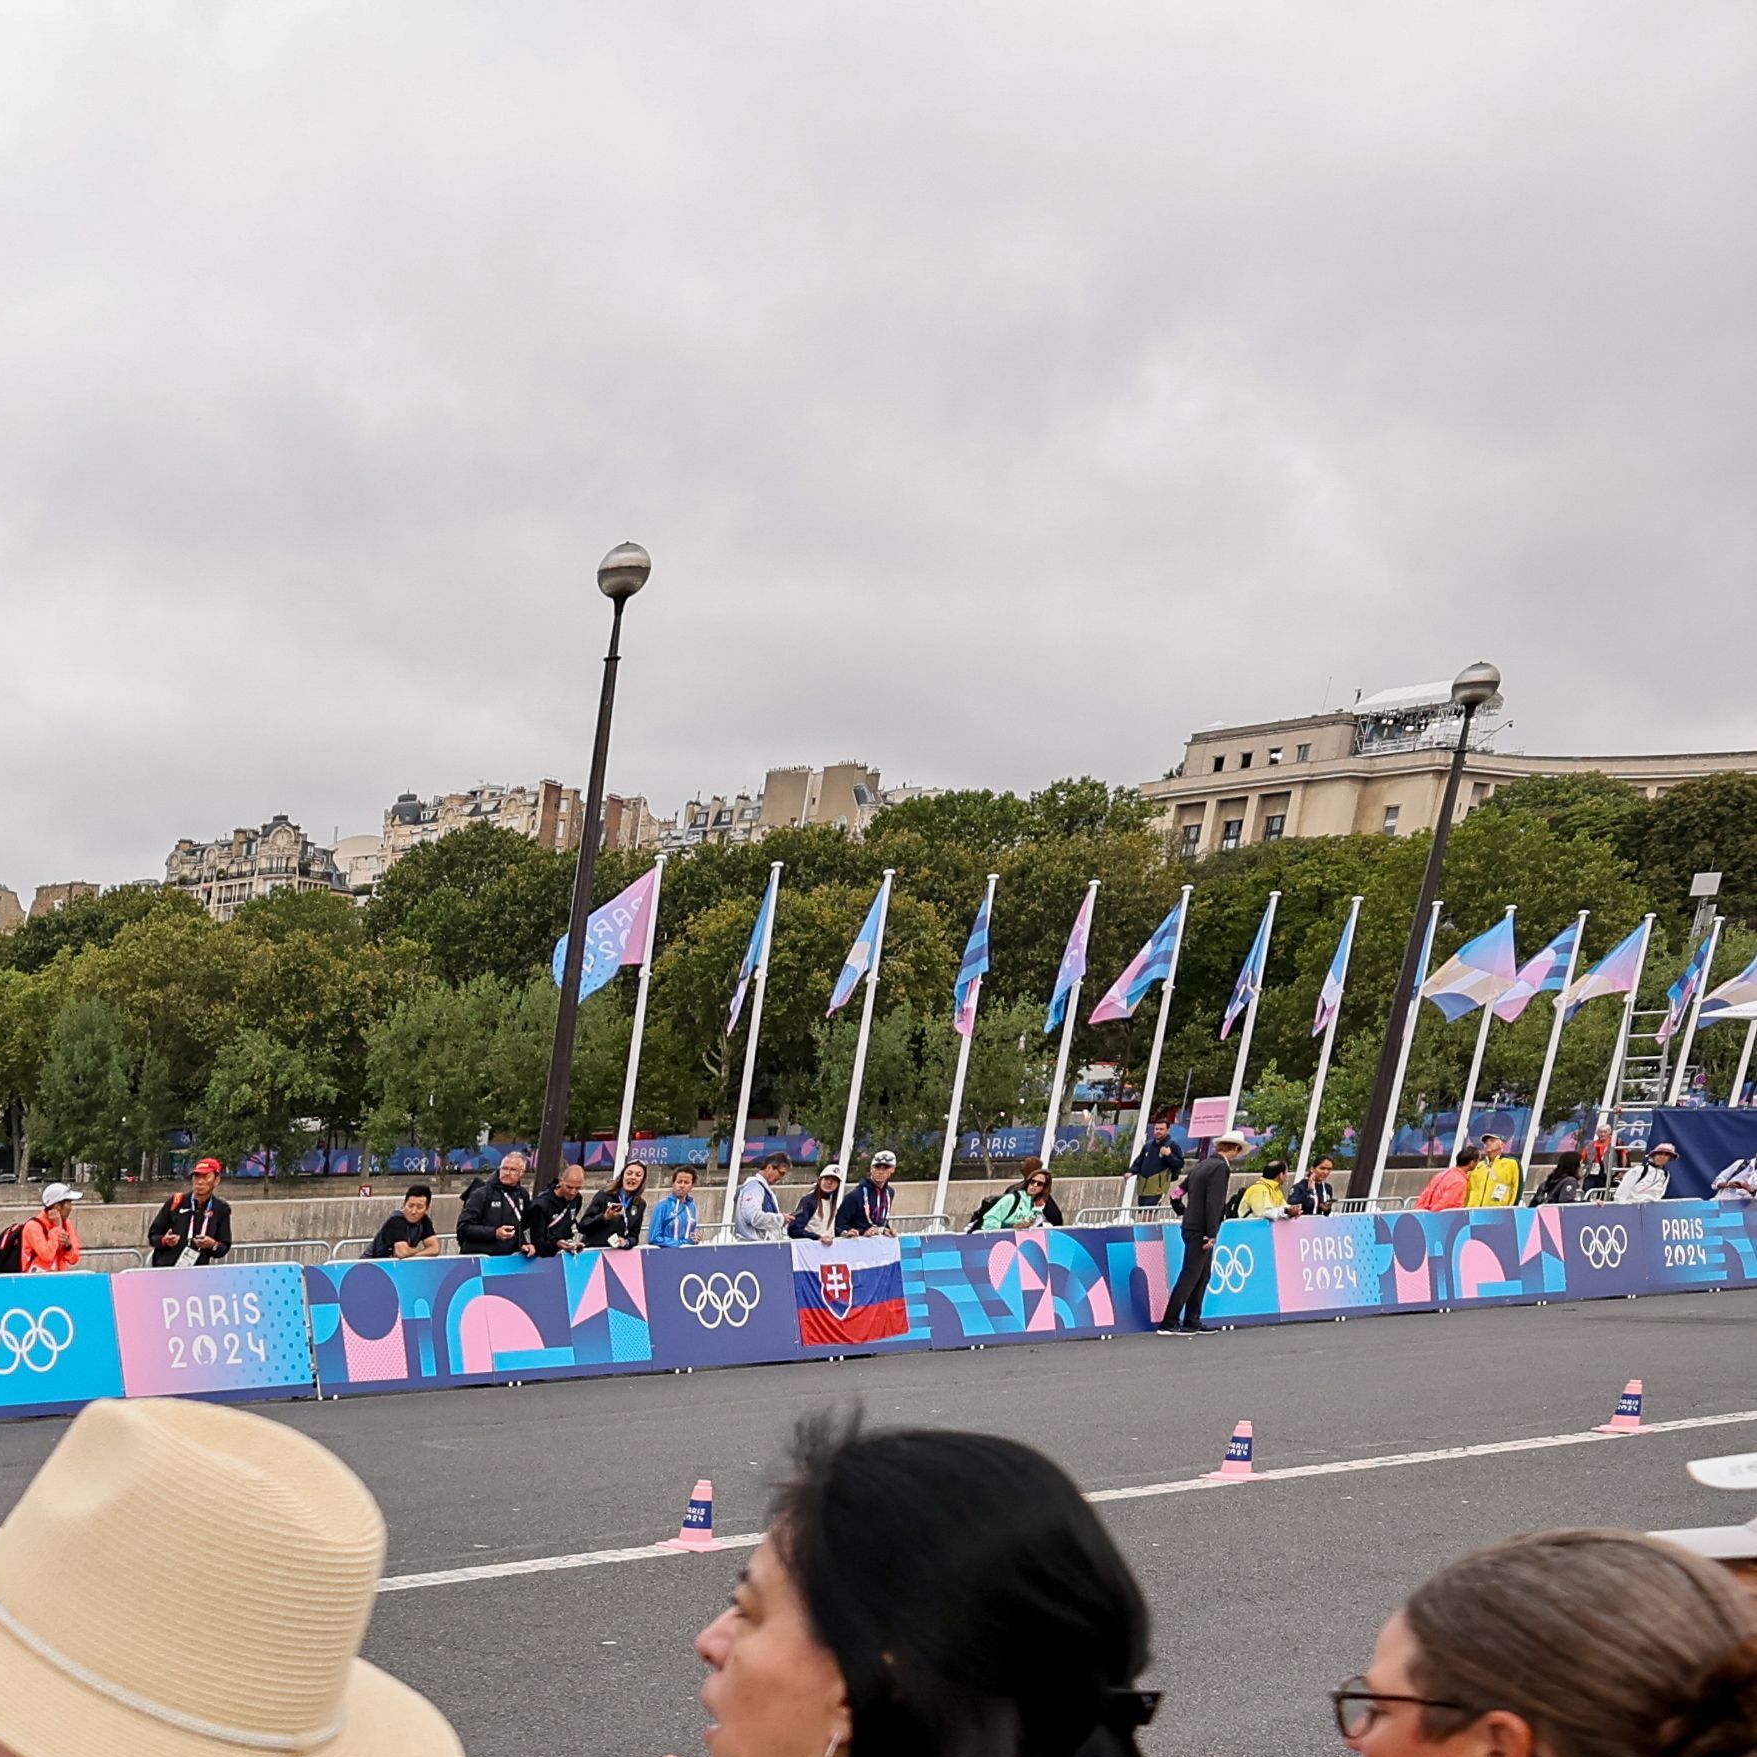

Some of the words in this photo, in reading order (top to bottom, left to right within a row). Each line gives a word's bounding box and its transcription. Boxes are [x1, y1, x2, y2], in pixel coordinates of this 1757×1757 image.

[1664, 1243, 1707, 1267] 2024
[1302, 1264, 1358, 1292] 2024
[168, 1331, 266, 1369] 2024
